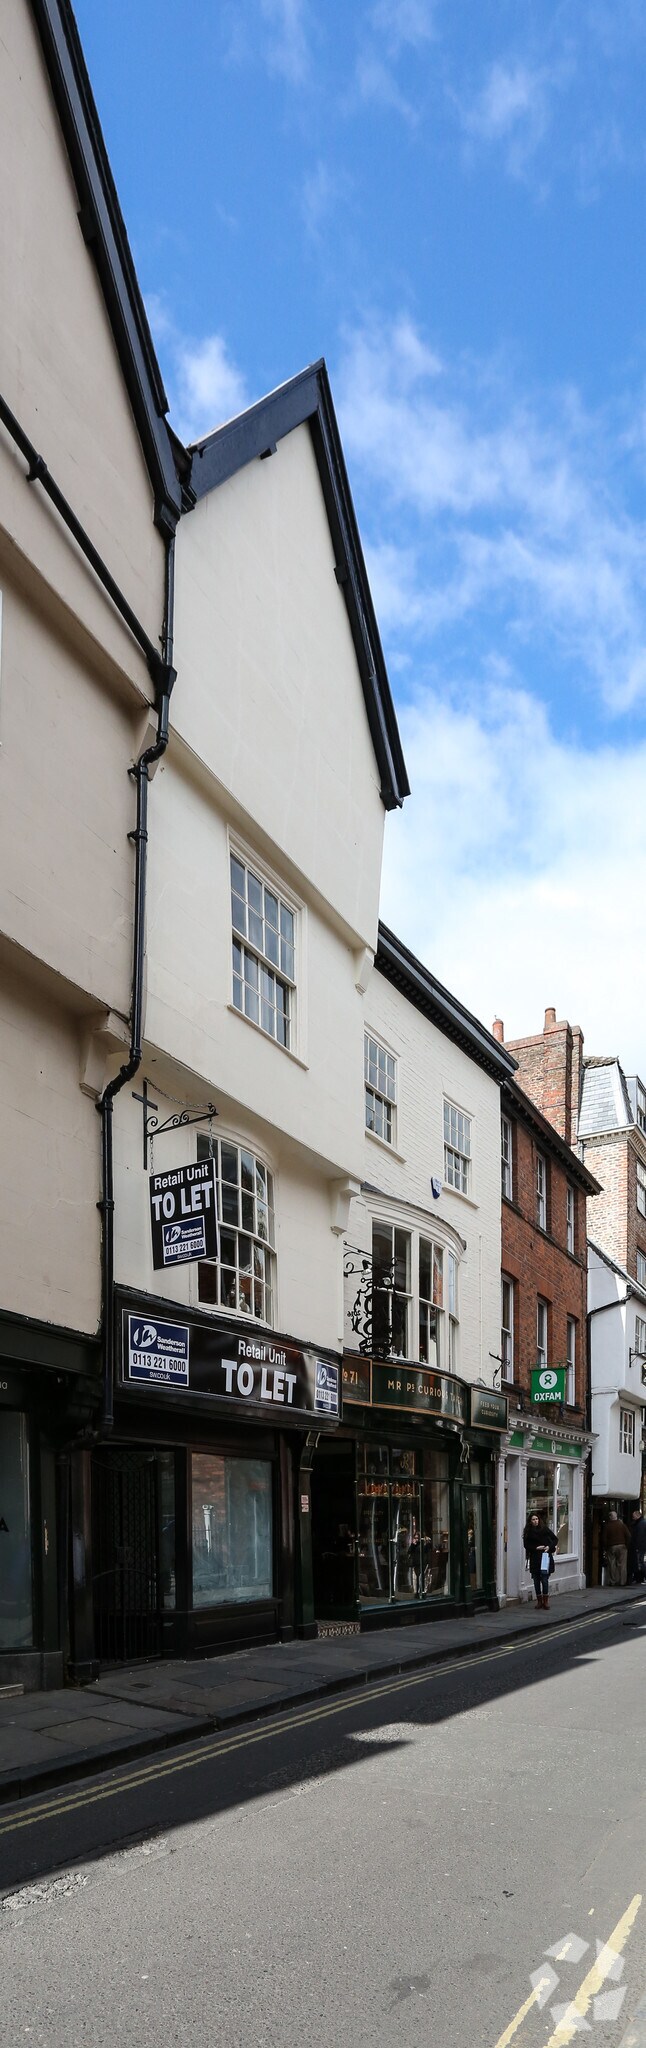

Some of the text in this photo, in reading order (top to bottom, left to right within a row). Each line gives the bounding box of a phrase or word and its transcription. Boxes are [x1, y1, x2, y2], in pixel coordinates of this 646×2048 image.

[154, 1164, 209, 1190] Retail Unit
[151, 1180, 213, 1221] TO LET
[165, 1244, 178, 1255] 0113
[179, 1242, 189, 1252] 221
[157, 1335, 185, 1347] Sanderson
[157, 1343, 185, 1354] Weatherall
[238, 1339, 287, 1366] Retail Unit
[133, 1352, 186, 1373] 0113 221 6000
[221, 1358, 297, 1404] TO LET
[349, 1370, 358, 1385] 71
[387, 1379, 402, 1391] MR
[534, 1391, 562, 1402] OXFAM
